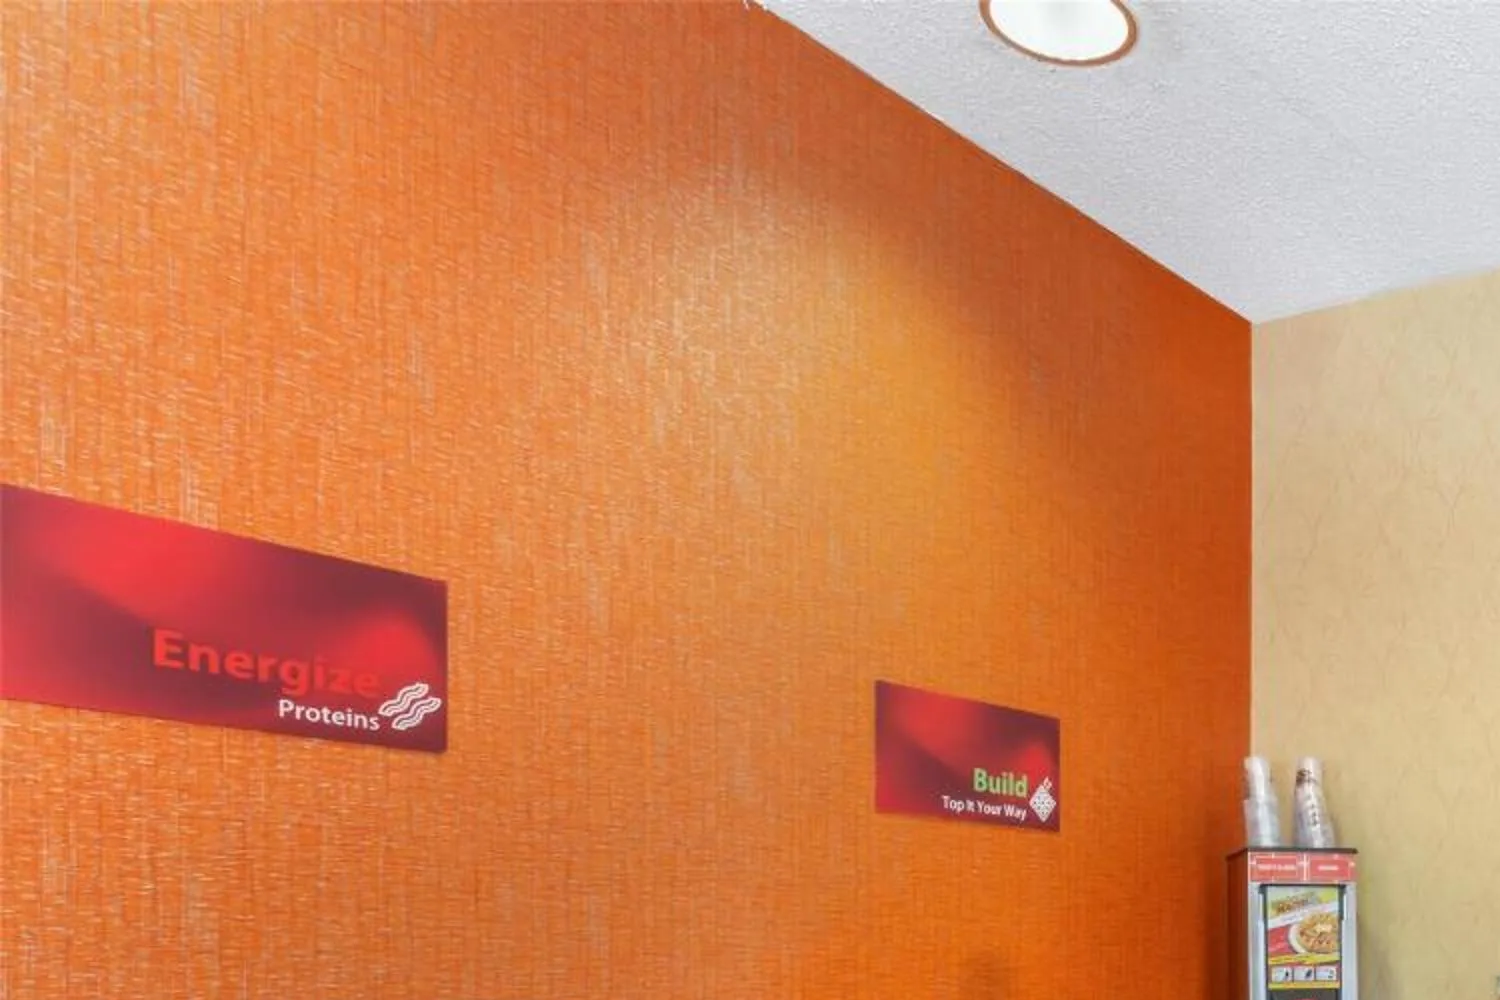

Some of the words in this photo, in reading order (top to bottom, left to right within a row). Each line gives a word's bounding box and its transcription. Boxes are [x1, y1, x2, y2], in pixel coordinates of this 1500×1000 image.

[153, 627, 381, 698] Energize
[278, 698, 381, 731] Proteins
[973, 767, 1027, 798] Build
[942, 795, 965, 813] Top
[976, 800, 1002, 815] Your
[1003, 803, 1027, 821] Way
